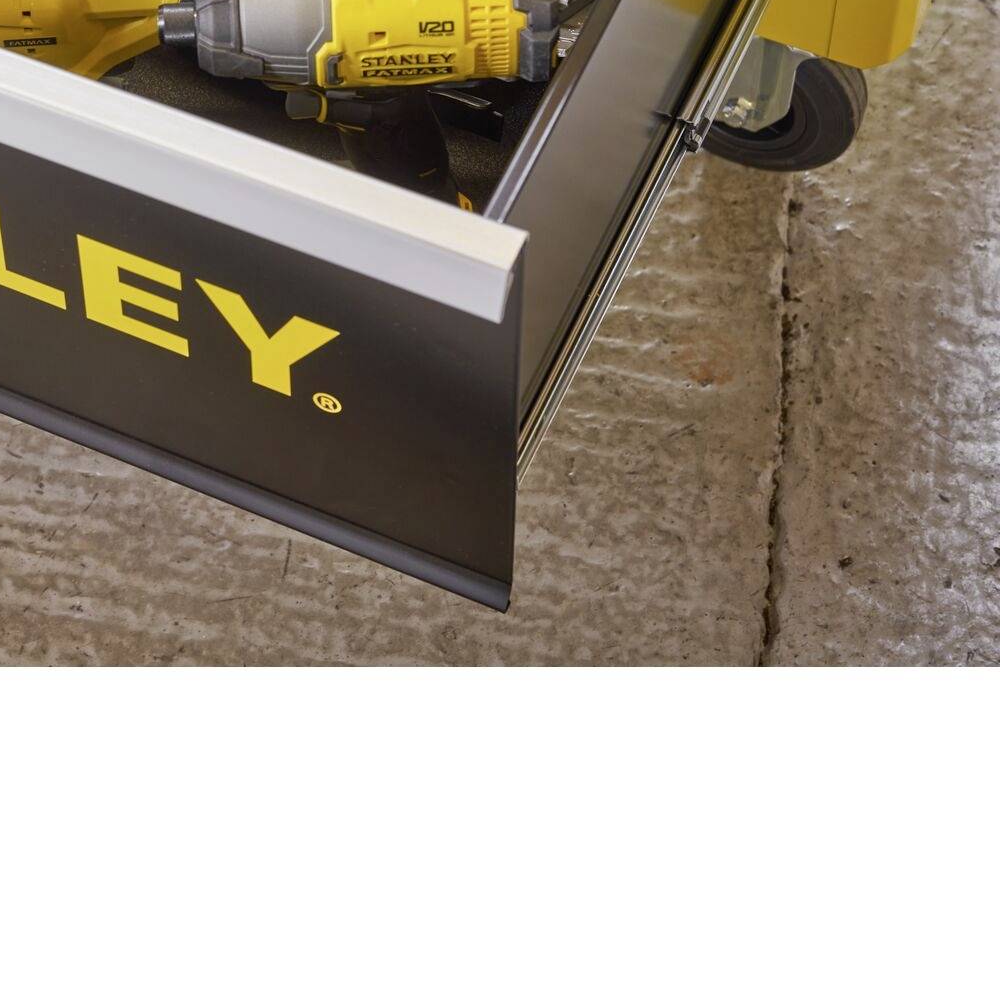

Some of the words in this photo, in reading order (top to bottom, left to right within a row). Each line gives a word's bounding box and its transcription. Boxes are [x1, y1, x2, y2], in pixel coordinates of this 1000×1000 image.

[419, 20, 456, 34] V20
[8, 39, 52, 47] FATMAX
[361, 53, 457, 68] STANLEY
[366, 67, 450, 77] FATMAX
